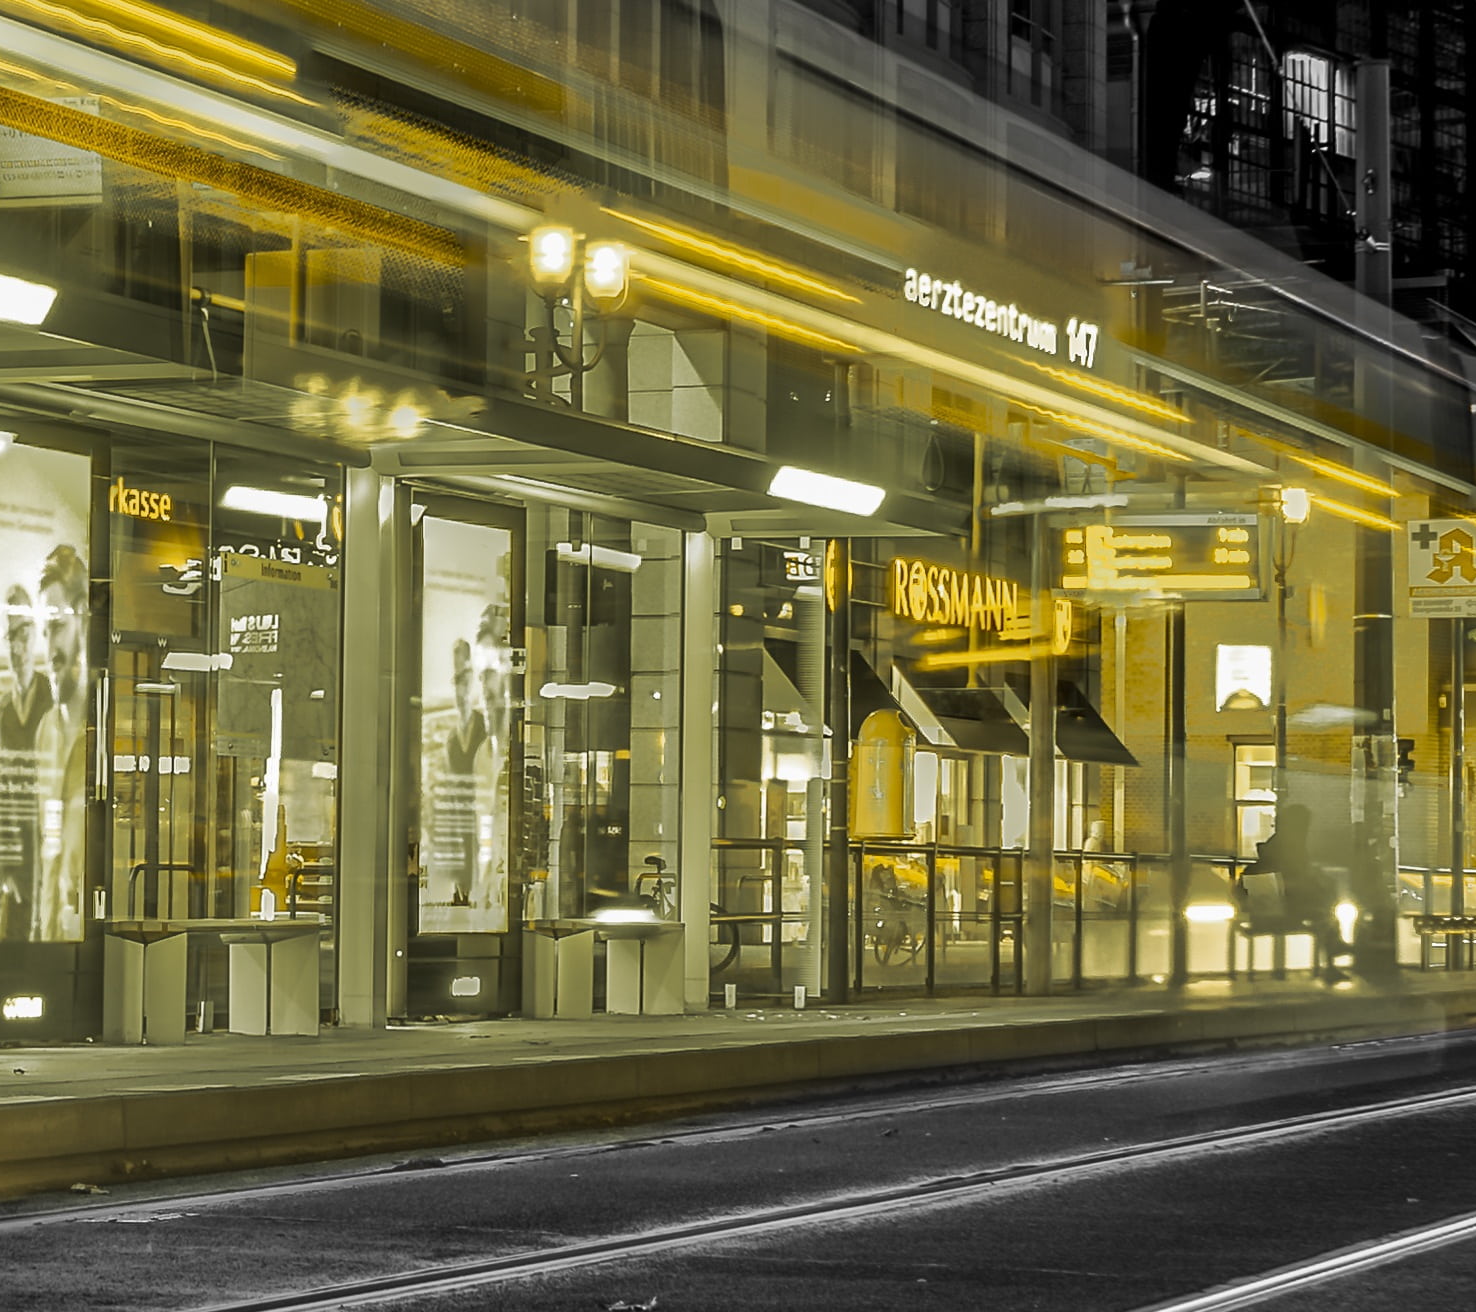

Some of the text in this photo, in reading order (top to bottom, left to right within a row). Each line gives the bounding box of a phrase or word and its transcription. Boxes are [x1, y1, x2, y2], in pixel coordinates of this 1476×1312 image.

[904, 268, 1098, 368] aerztezentrum 147
[261, 563, 302, 582] Information
[894, 557, 1018, 632] ROSSMANN
